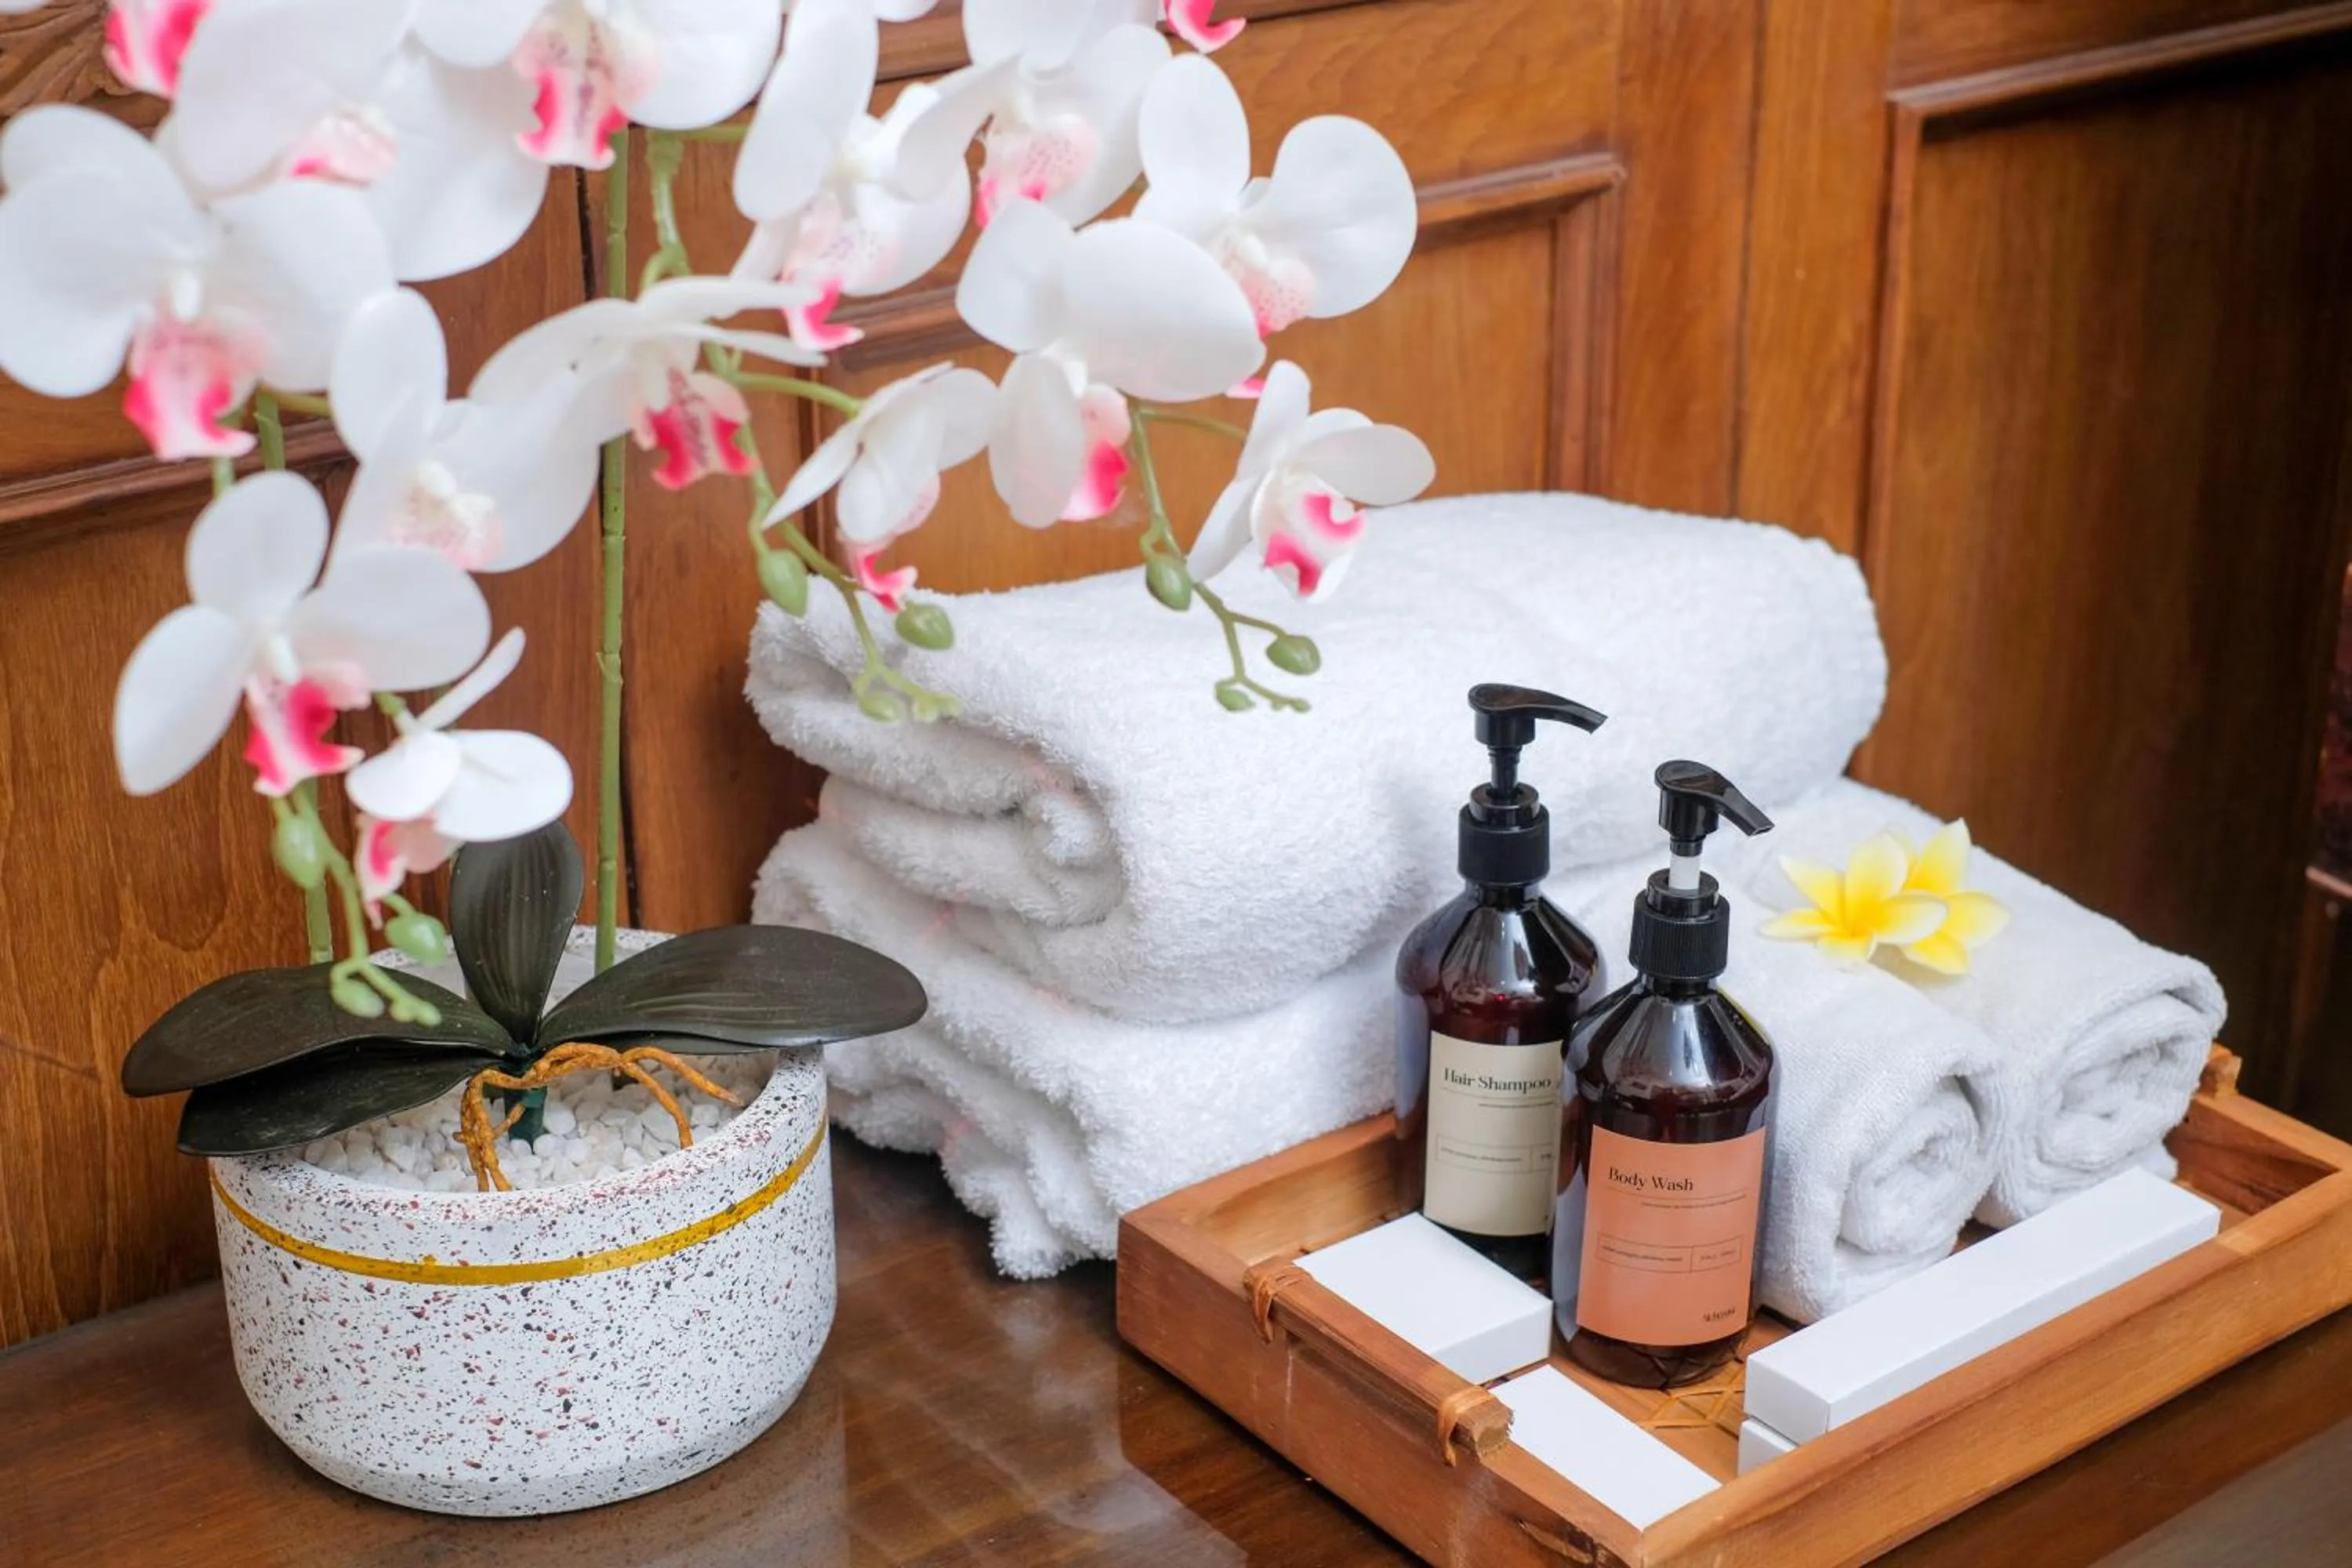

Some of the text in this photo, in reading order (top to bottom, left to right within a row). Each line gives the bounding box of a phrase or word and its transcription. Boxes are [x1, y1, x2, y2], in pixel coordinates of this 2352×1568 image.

[1444, 1067, 1552, 1094] Hair Shampoo
[1608, 1166, 1694, 1192] Body Wash
